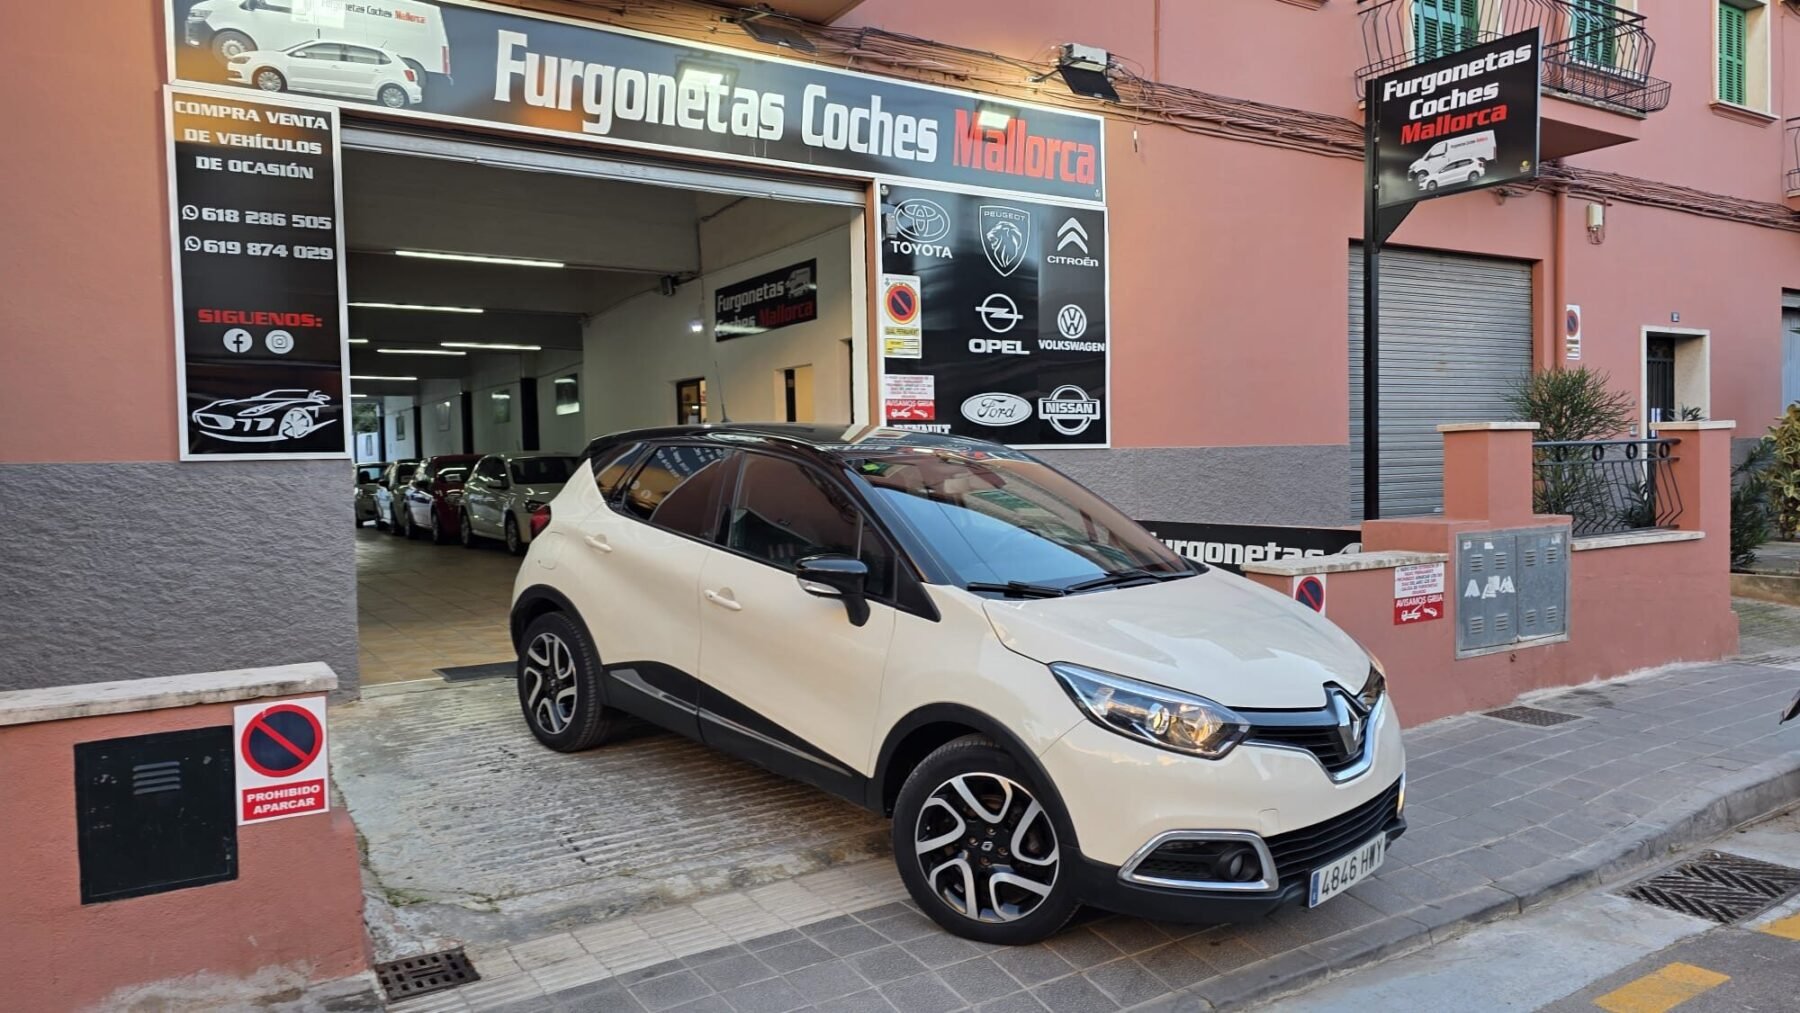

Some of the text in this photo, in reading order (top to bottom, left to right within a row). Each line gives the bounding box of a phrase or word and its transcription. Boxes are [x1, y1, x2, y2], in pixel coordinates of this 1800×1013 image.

[1383, 44, 1532, 102] Furgonetas
[494, 29, 1096, 186] Furgonetas Coches Mallorca
[1408, 82, 1500, 120] Coches
[174, 101, 330, 131] COMPRA VENTA
[1400, 104, 1508, 146] Mallorca
[183, 128, 323, 155] DE VEHÍCULOS
[195, 155, 315, 180] DE OCASIÓN
[201, 207, 332, 230] 618 286 505
[983, 210, 1026, 222] PEUGEOT
[203, 239, 334, 261] 619 874 029
[889, 240, 953, 259] TOYOTA
[1046, 254, 1099, 268] CITROËN
[716, 280, 785, 313] Furgonetas
[197, 308, 323, 328] SIGUENOS:
[759, 300, 813, 327] Mallorca
[968, 338, 1031, 355] OPEL
[1038, 339, 1106, 352] VOLKSWAGEN
[977, 399, 1017, 419] Ford
[1045, 402, 1094, 415] NISSAN
[246, 784, 321, 803] PROHIBIDO
[253, 797, 316, 815] APARCAR
[1321, 856, 1358, 896] 4846
